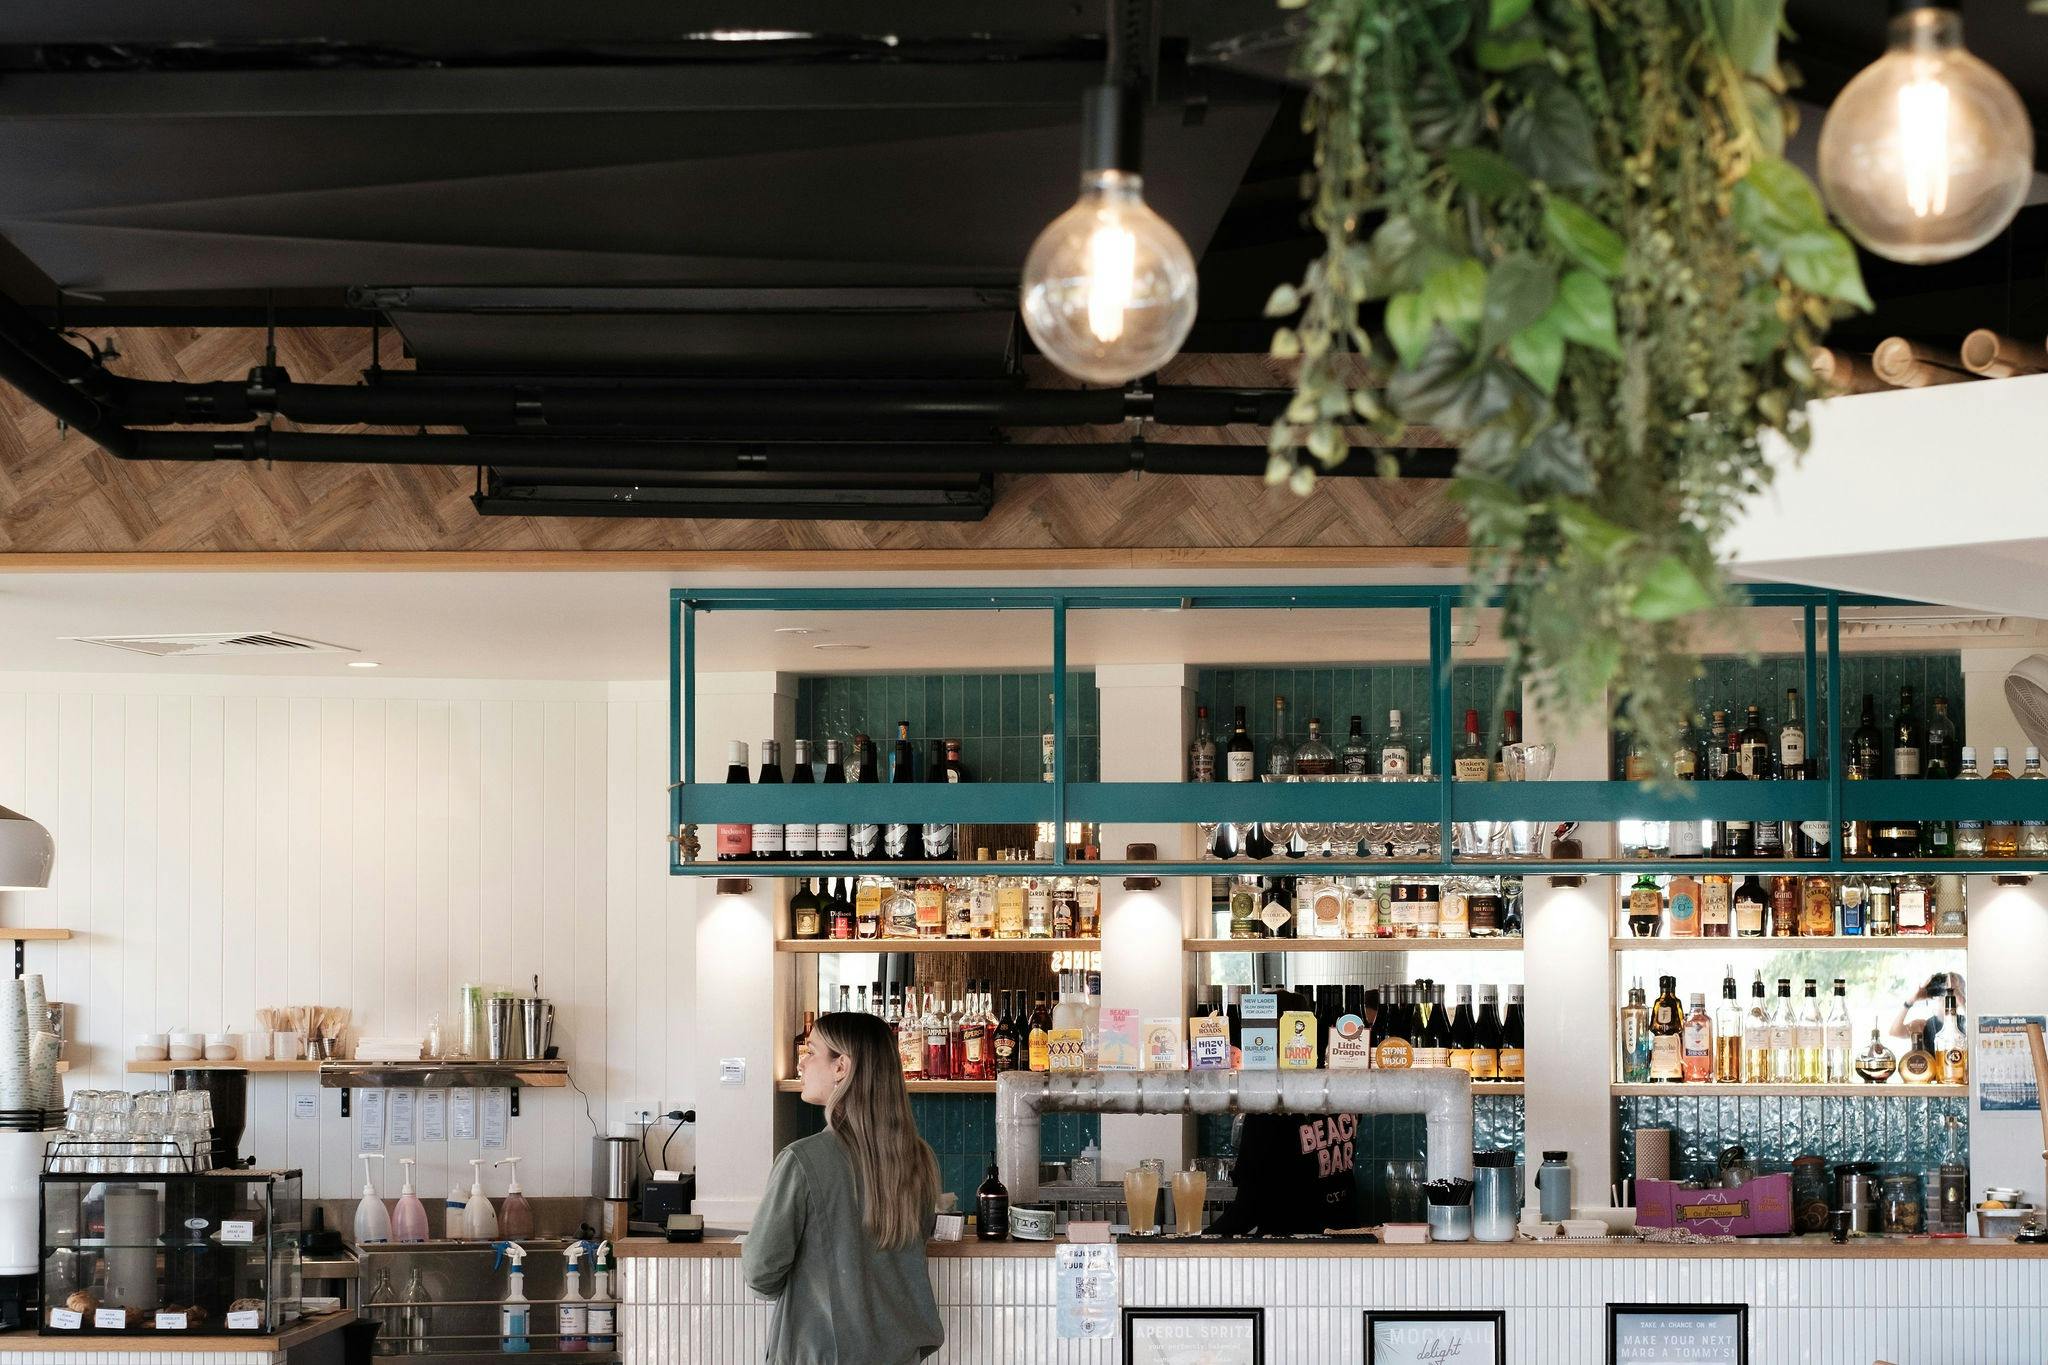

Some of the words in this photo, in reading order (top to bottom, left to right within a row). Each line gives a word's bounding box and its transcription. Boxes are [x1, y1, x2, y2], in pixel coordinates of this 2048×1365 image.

[1047, 1041, 1085, 1055] XXXX
[1285, 1046, 1314, 1059] LARRY
[1332, 1048, 1366, 1057] Dragon
[1051, 1055, 1083, 1068] GOLD
[1950, 1051, 1961, 1061] 43
[1318, 1141, 1354, 1178] BAR
[1015, 1217, 1041, 1229] TIPS
[1136, 1326, 1194, 1338] APEROL
[1200, 1326, 1252, 1338] SPRITZ
[1390, 1328, 1493, 1345] MOCKTAIL
[1624, 1335, 1657, 1345] MAKE
[1664, 1335, 1695, 1345] YOUR
[1702, 1335, 1733, 1345] NEXT
[1416, 1336, 1463, 1360] delight
[1621, 1348, 1655, 1358] MARG
[1661, 1348, 1671, 1358] A
